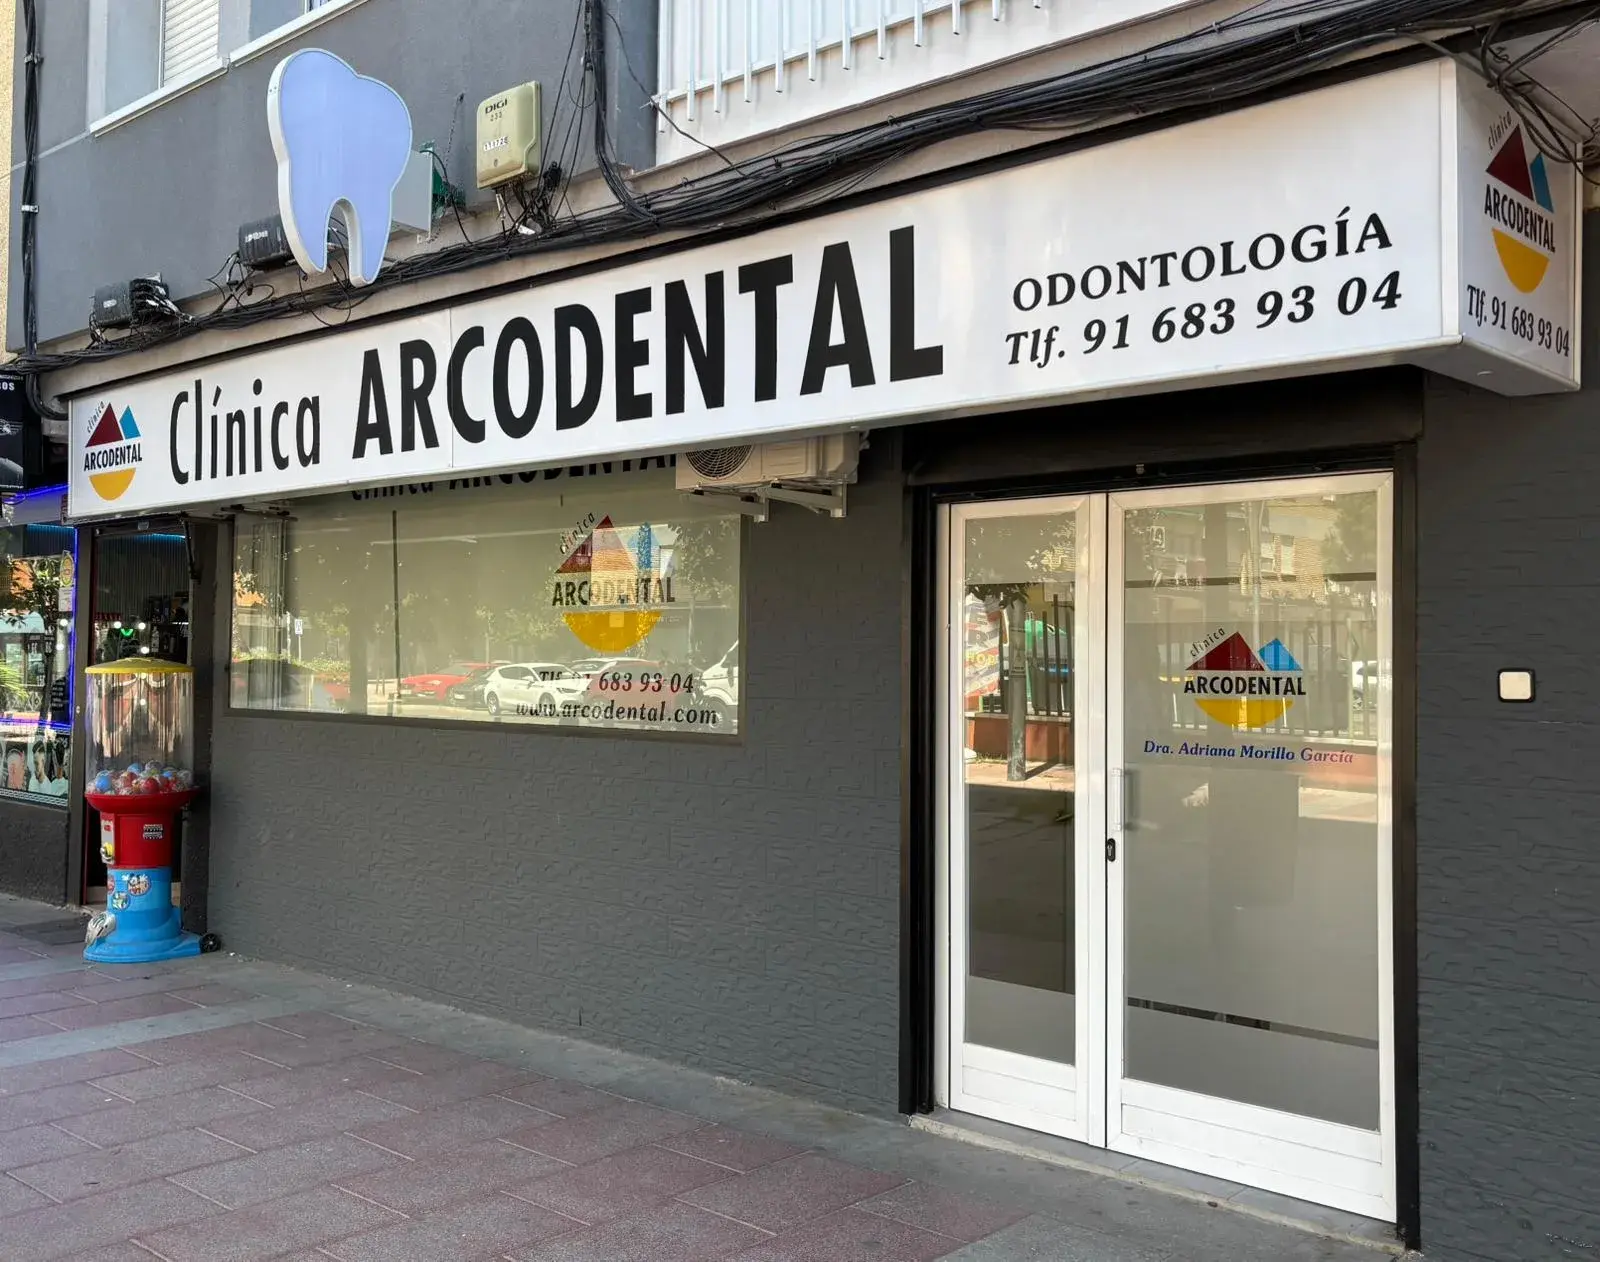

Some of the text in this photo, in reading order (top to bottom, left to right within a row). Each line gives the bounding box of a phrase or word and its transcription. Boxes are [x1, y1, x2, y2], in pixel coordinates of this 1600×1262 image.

[485, 99, 508, 114] DIGI
[1484, 183, 1556, 253] ARCODENTAL
[1013, 206, 1393, 312] ODONTOLOGÍA
[1005, 270, 1402, 369] Tlf. 91 683 93 04
[1467, 284, 1570, 357] Tlf. 91 683 93 04
[169, 225, 944, 486] Clínica ARCODENTAL
[0, 381, 15, 391] OS
[84, 443, 143, 472] ARCODENTAL
[598, 671, 633, 693] 683
[639, 671, 663, 693] 93
[670, 672, 694, 694] 04
[1183, 675, 1307, 696] ARCODENTAL
[515, 698, 719, 725] www.arcodental.com
[1143, 740, 1354, 764] Dra. Adriana Morillo García
